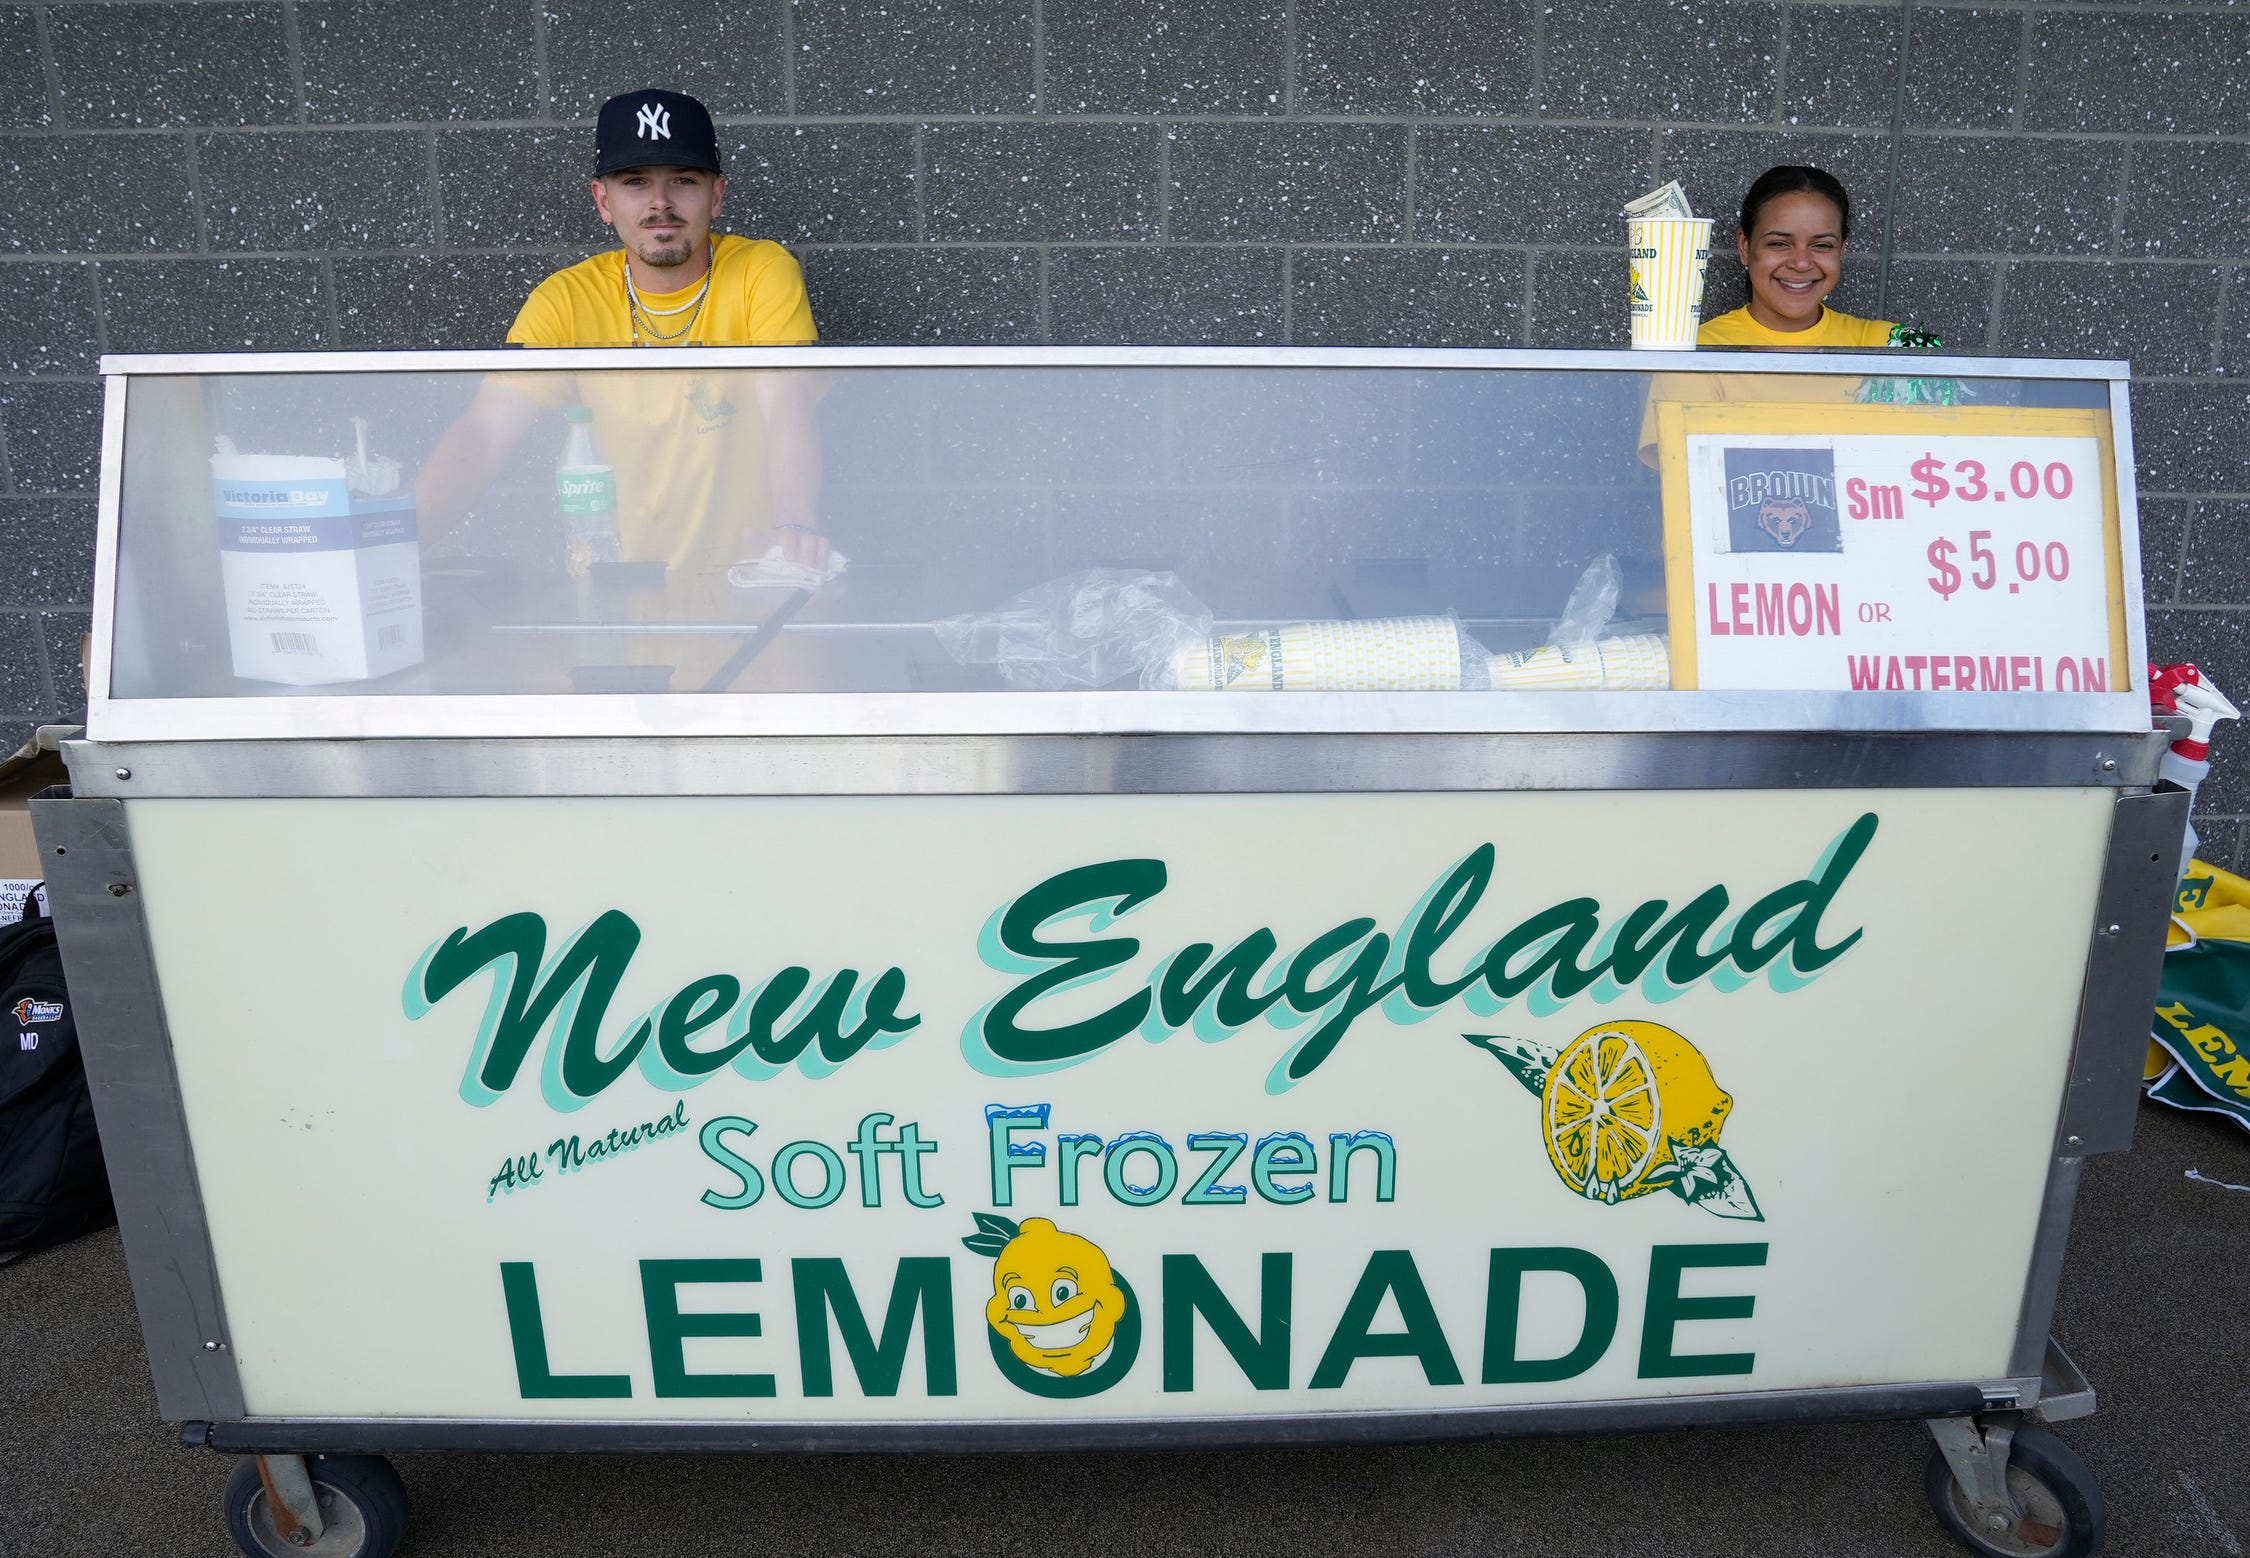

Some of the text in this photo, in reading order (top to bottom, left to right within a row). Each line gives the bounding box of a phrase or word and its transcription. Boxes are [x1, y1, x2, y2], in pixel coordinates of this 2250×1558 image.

[636, 103, 671, 140] NY
[223, 490, 289, 503] Victoria
[562, 480, 604, 498] Sprite
[1730, 471, 1836, 510] BROWN
[1846, 451, 2074, 520] Sm $3.00
[261, 526, 283, 534] CLEAR
[284, 525, 311, 534] STRAW
[282, 535, 318, 544] WRAPPED
[1927, 530, 2071, 601] $5.00
[1708, 582, 1892, 636] LEMON OR
[412, 811, 1878, 1104] New England
[20, 1033, 38, 1050] MD
[488, 1100, 691, 1200] All Natural
[699, 1104, 1397, 1210] Soft Frozen
